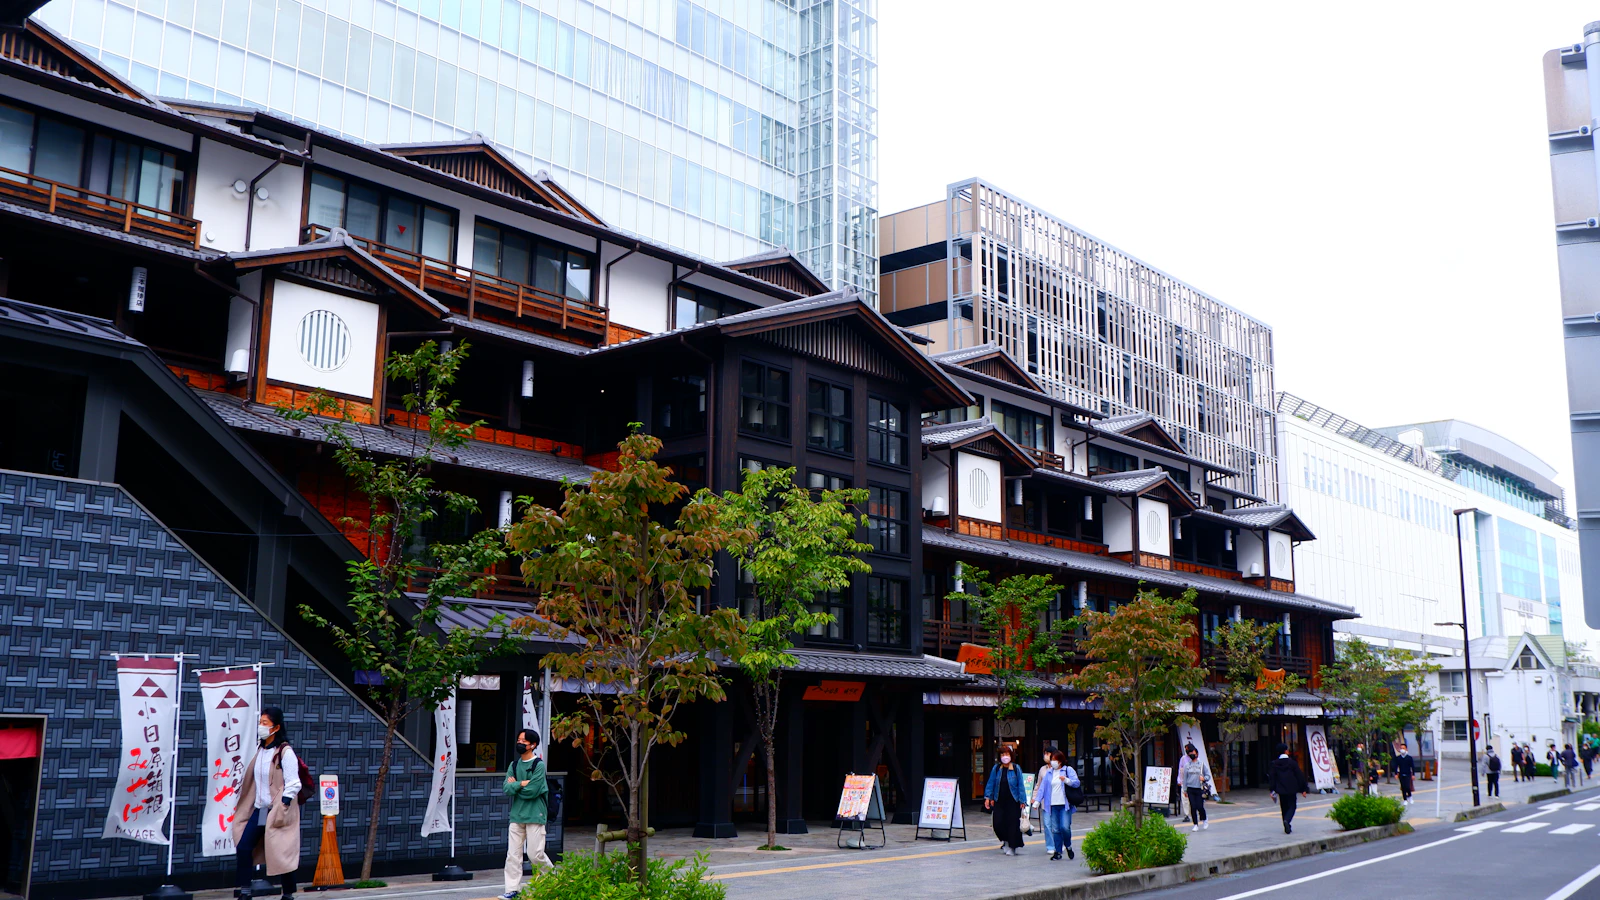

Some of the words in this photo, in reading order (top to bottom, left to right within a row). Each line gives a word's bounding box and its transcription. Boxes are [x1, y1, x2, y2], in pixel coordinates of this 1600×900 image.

[221, 713, 244, 798] 小田原
[1161, 768, 1171, 802] 朝むすび
[115, 825, 155, 840] MIYAGE
[214, 839, 235, 850] MIY
